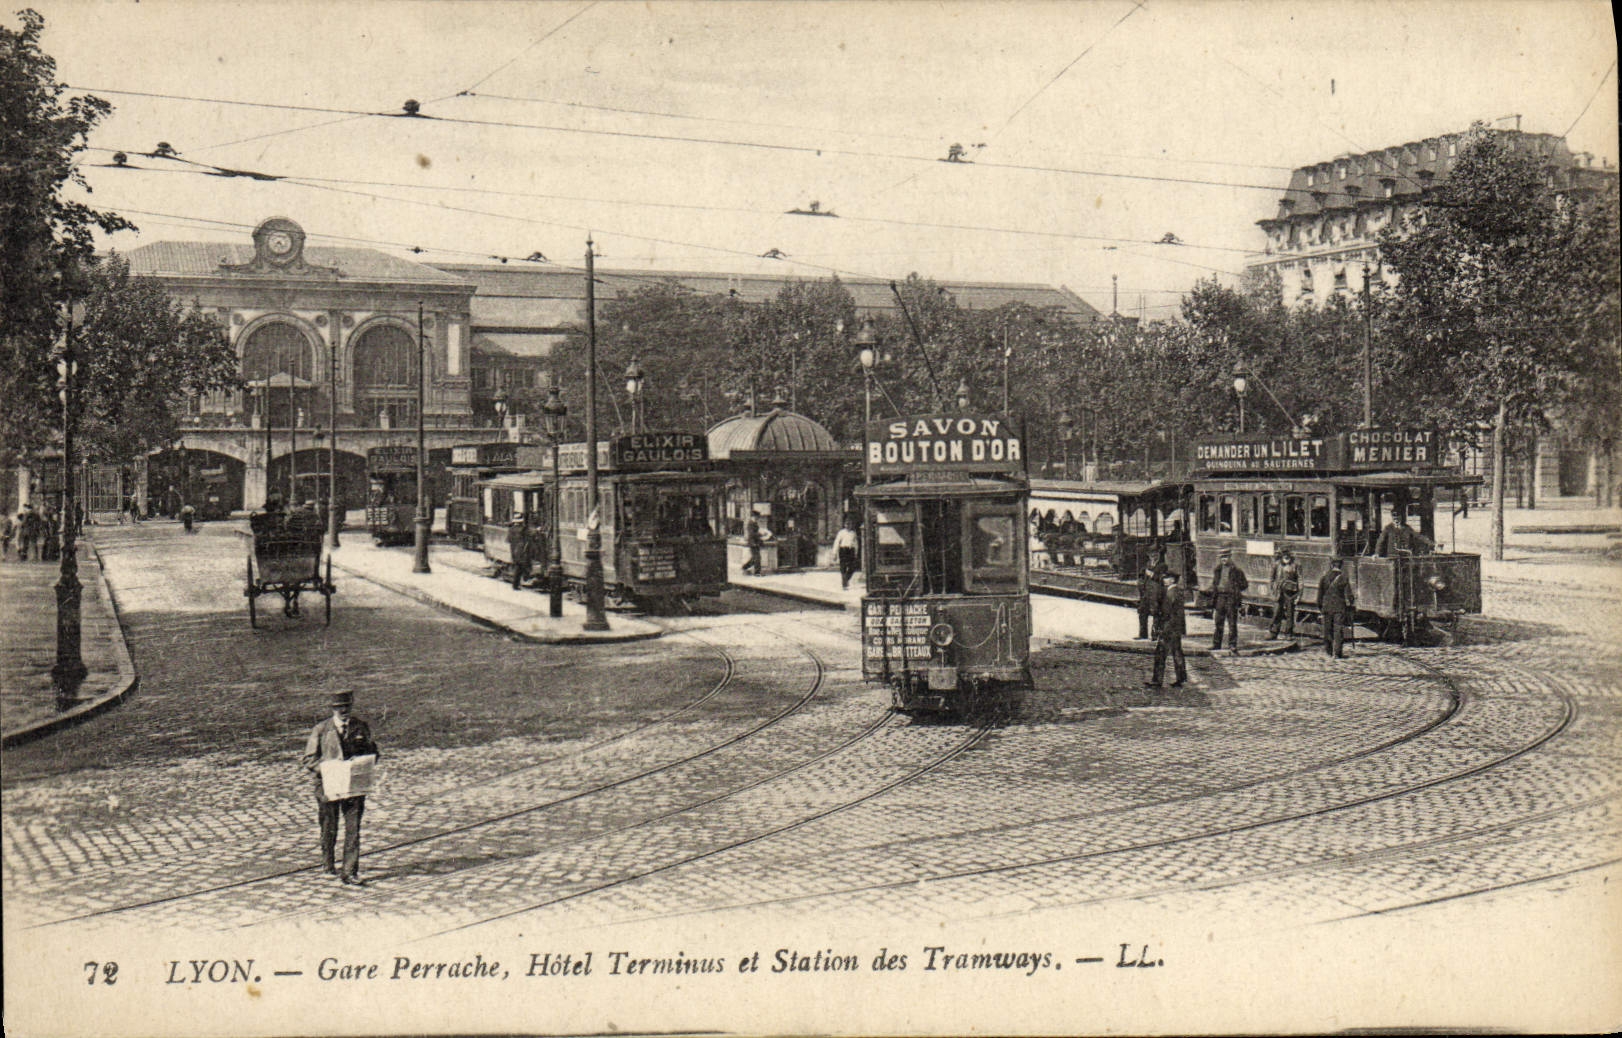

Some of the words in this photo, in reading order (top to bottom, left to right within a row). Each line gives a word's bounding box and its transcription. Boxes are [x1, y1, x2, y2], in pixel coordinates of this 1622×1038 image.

[889, 418, 1000, 439] SAVON
[631, 435, 694, 448] ELIXIR
[1350, 432, 1432, 444] CHOCOLAT
[623, 449, 703, 462] GAULOIS
[869, 440, 963, 464] BOUTON
[972, 438, 1020, 461] D'OR
[1197, 445, 1250, 459] DEMANDER
[1253, 444, 1268, 458] UN
[1271, 440, 1323, 457] LILET
[1353, 446, 1427, 462] MENIER
[1264, 459, 1314, 470] SAUTERNES
